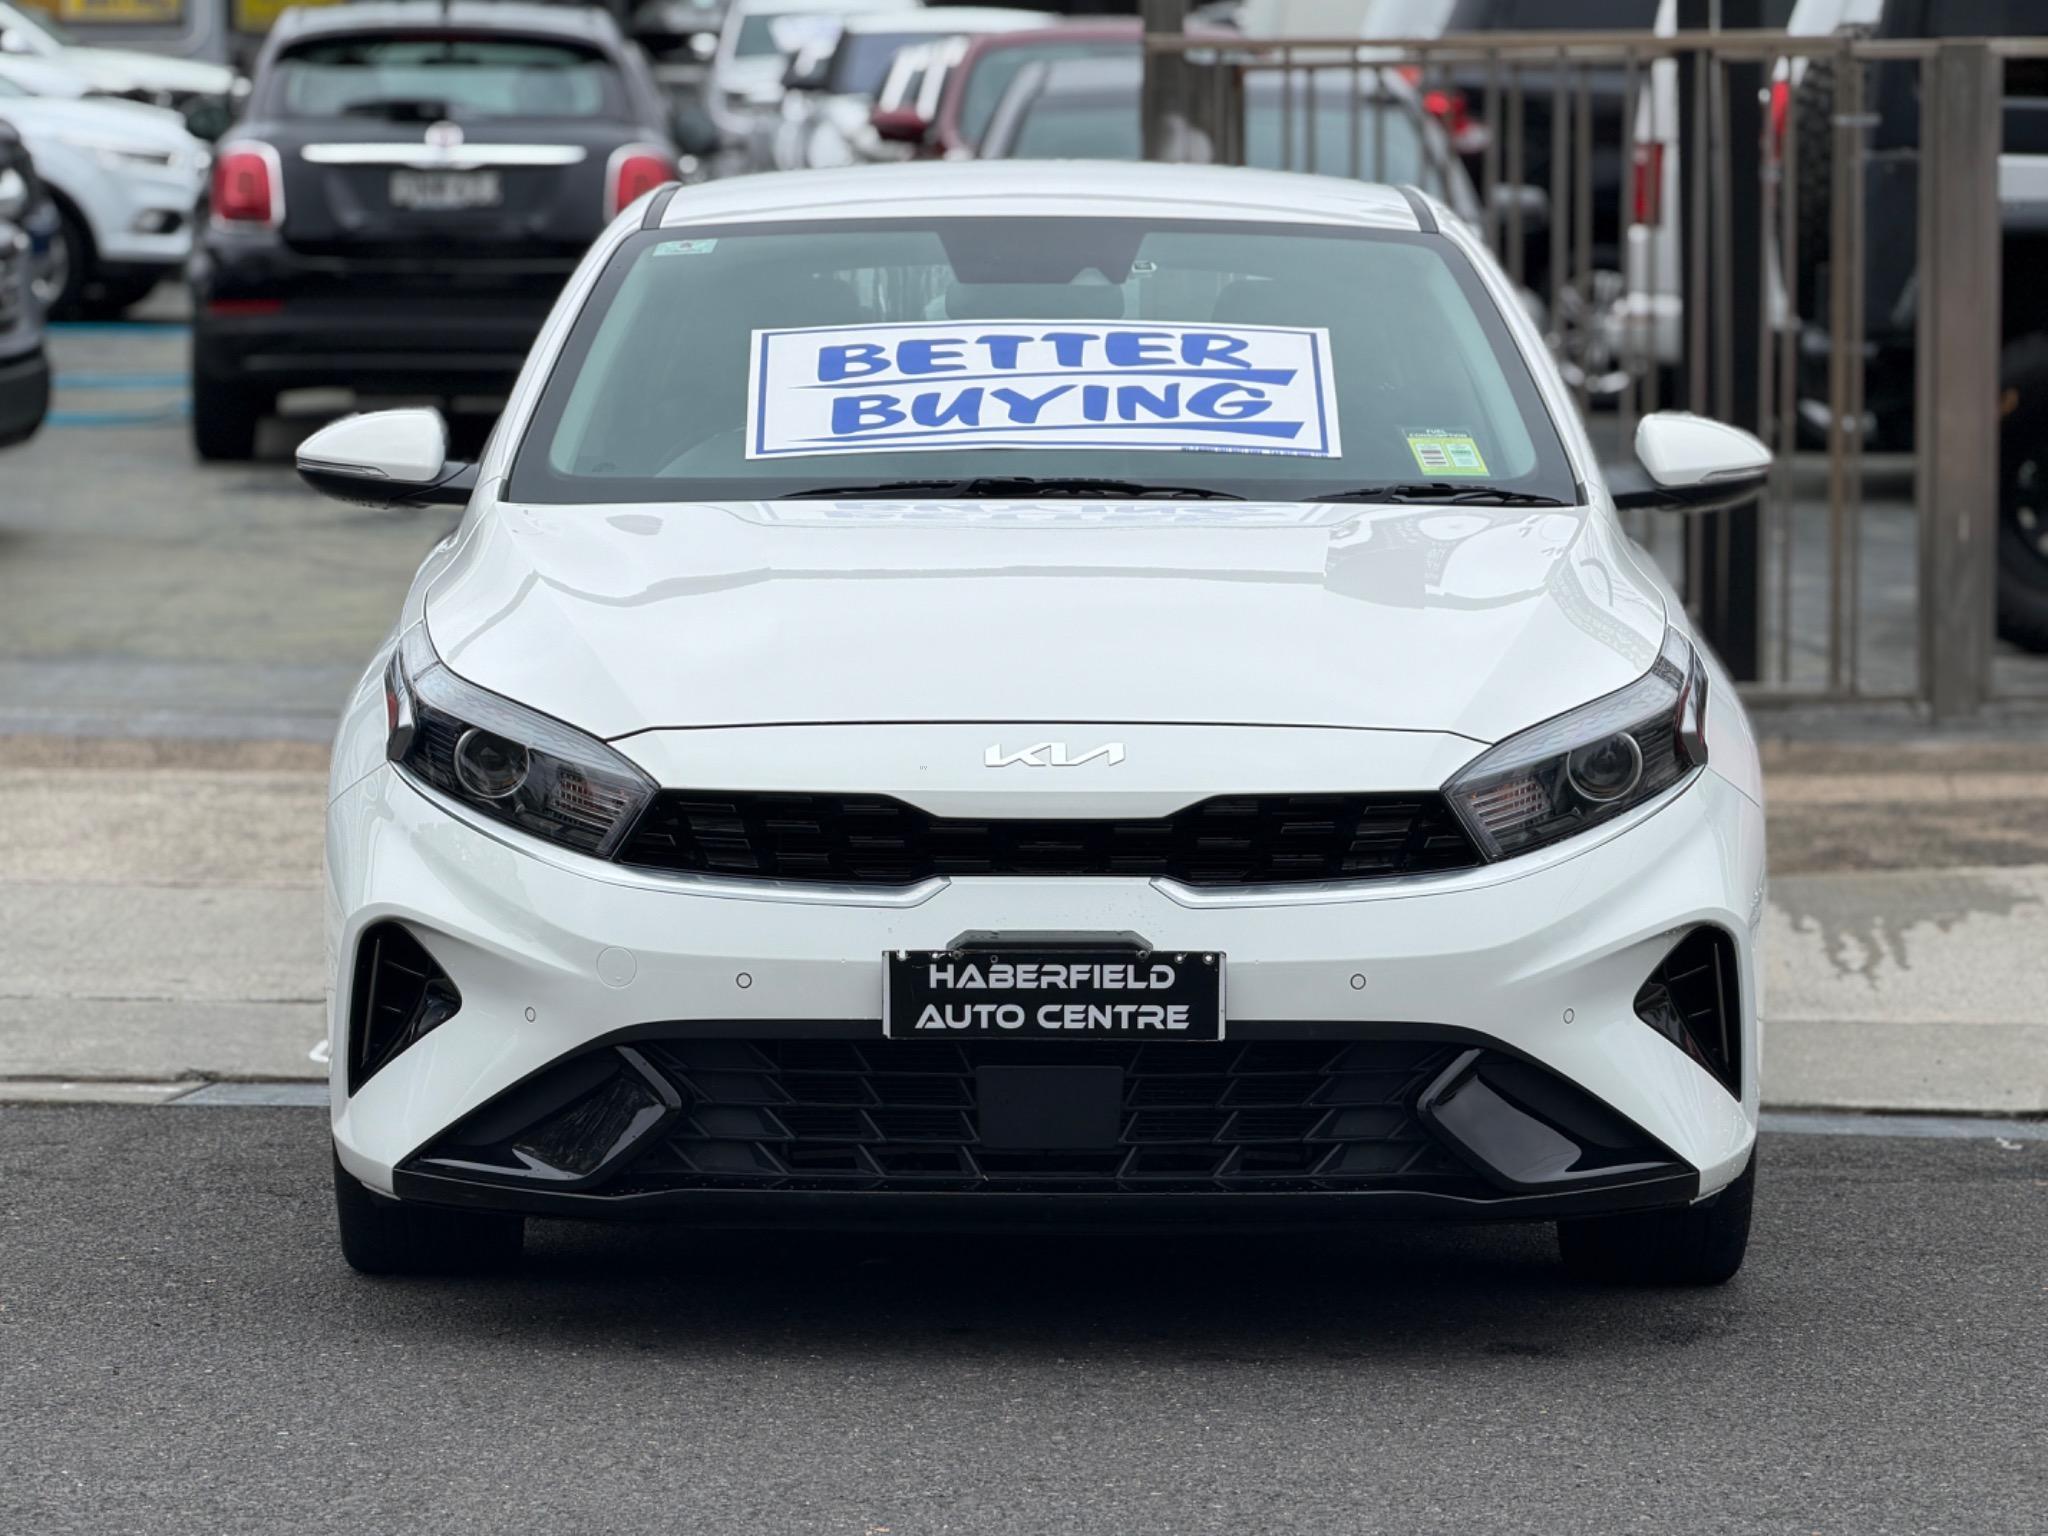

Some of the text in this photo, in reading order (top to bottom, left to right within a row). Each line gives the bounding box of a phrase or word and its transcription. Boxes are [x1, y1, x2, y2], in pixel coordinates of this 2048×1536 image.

[817, 331, 1253, 383] BETTER
[831, 383, 1273, 435] BUYING
[983, 741, 1126, 767] KIA
[929, 965, 1175, 989] HABERFIELD
[914, 1004, 1190, 1030] AUTO CENTRE
